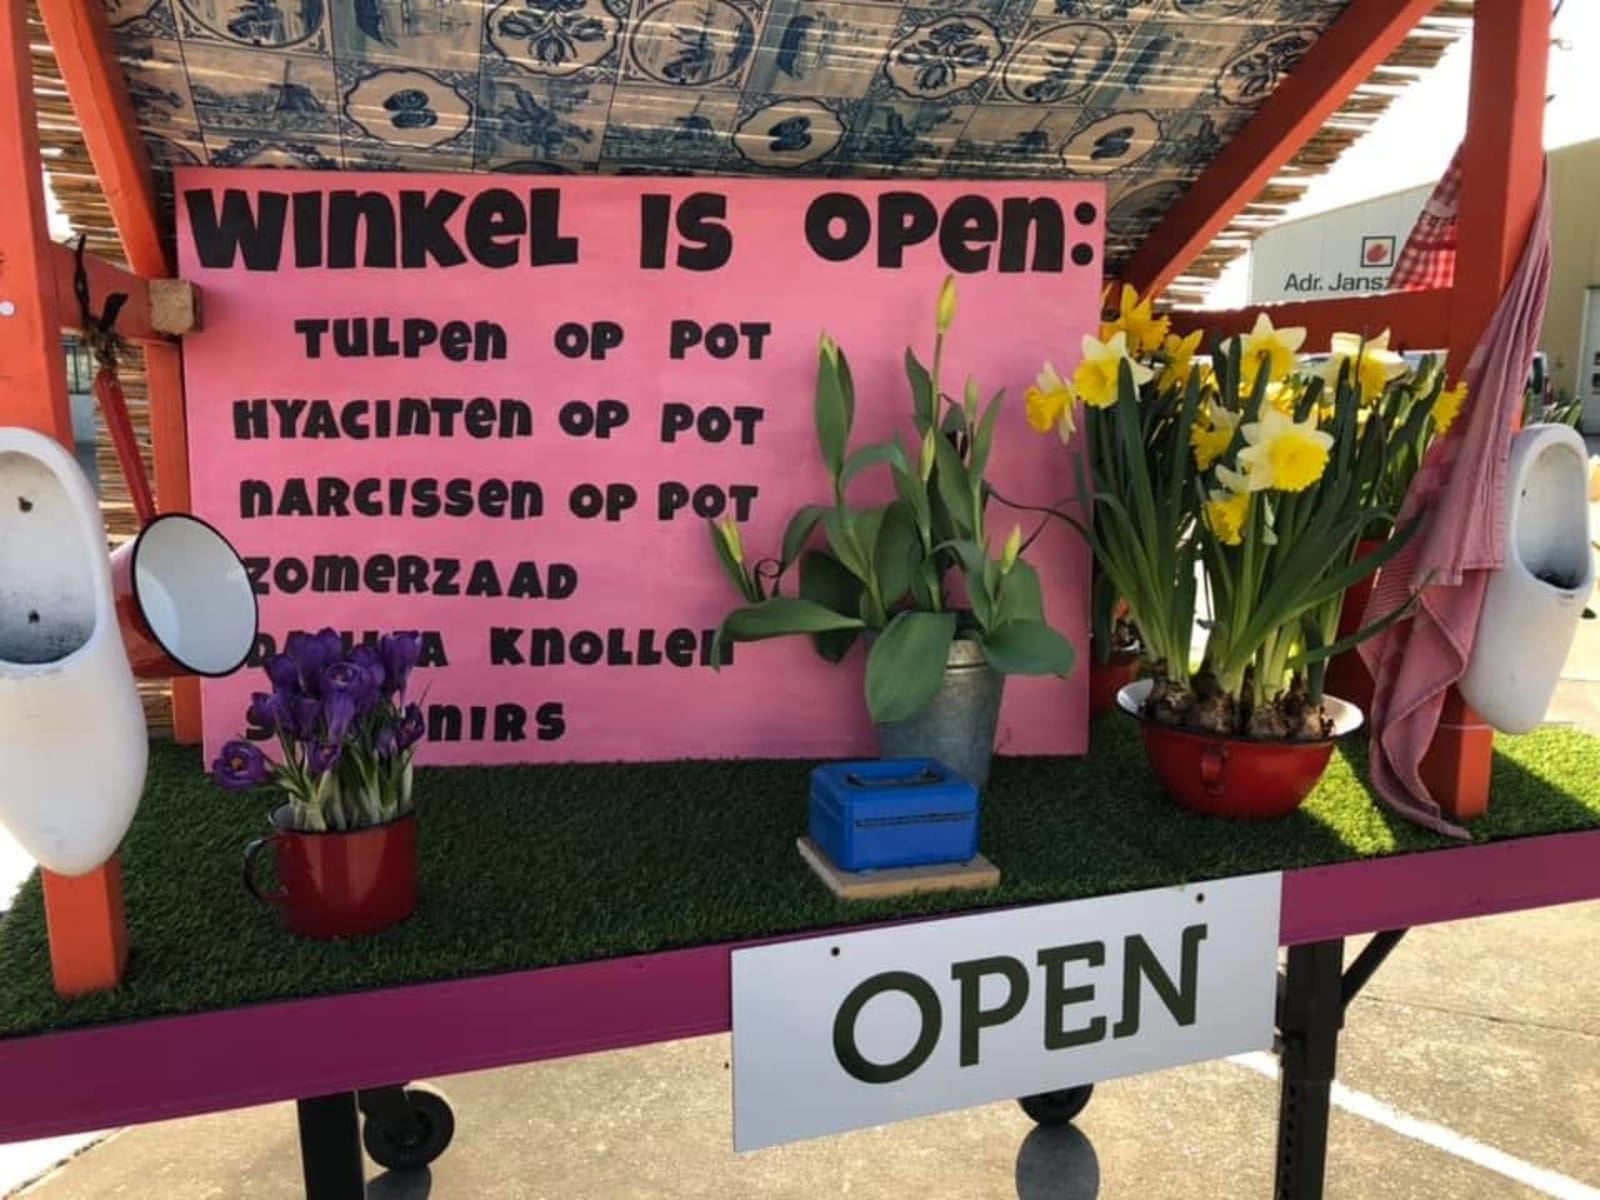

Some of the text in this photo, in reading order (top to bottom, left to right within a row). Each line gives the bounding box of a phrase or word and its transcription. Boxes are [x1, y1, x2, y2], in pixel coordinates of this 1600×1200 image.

[641, 193, 732, 271] IS
[1283, 272, 1323, 292] Adr.
[554, 321, 624, 360] OP
[669, 319, 771, 360] POT
[559, 400, 630, 439] OP
[661, 403, 764, 445] POT
[569, 484, 637, 521] OP
[658, 482, 759, 521] POT
[832, 924, 1207, 1084] OPEN
